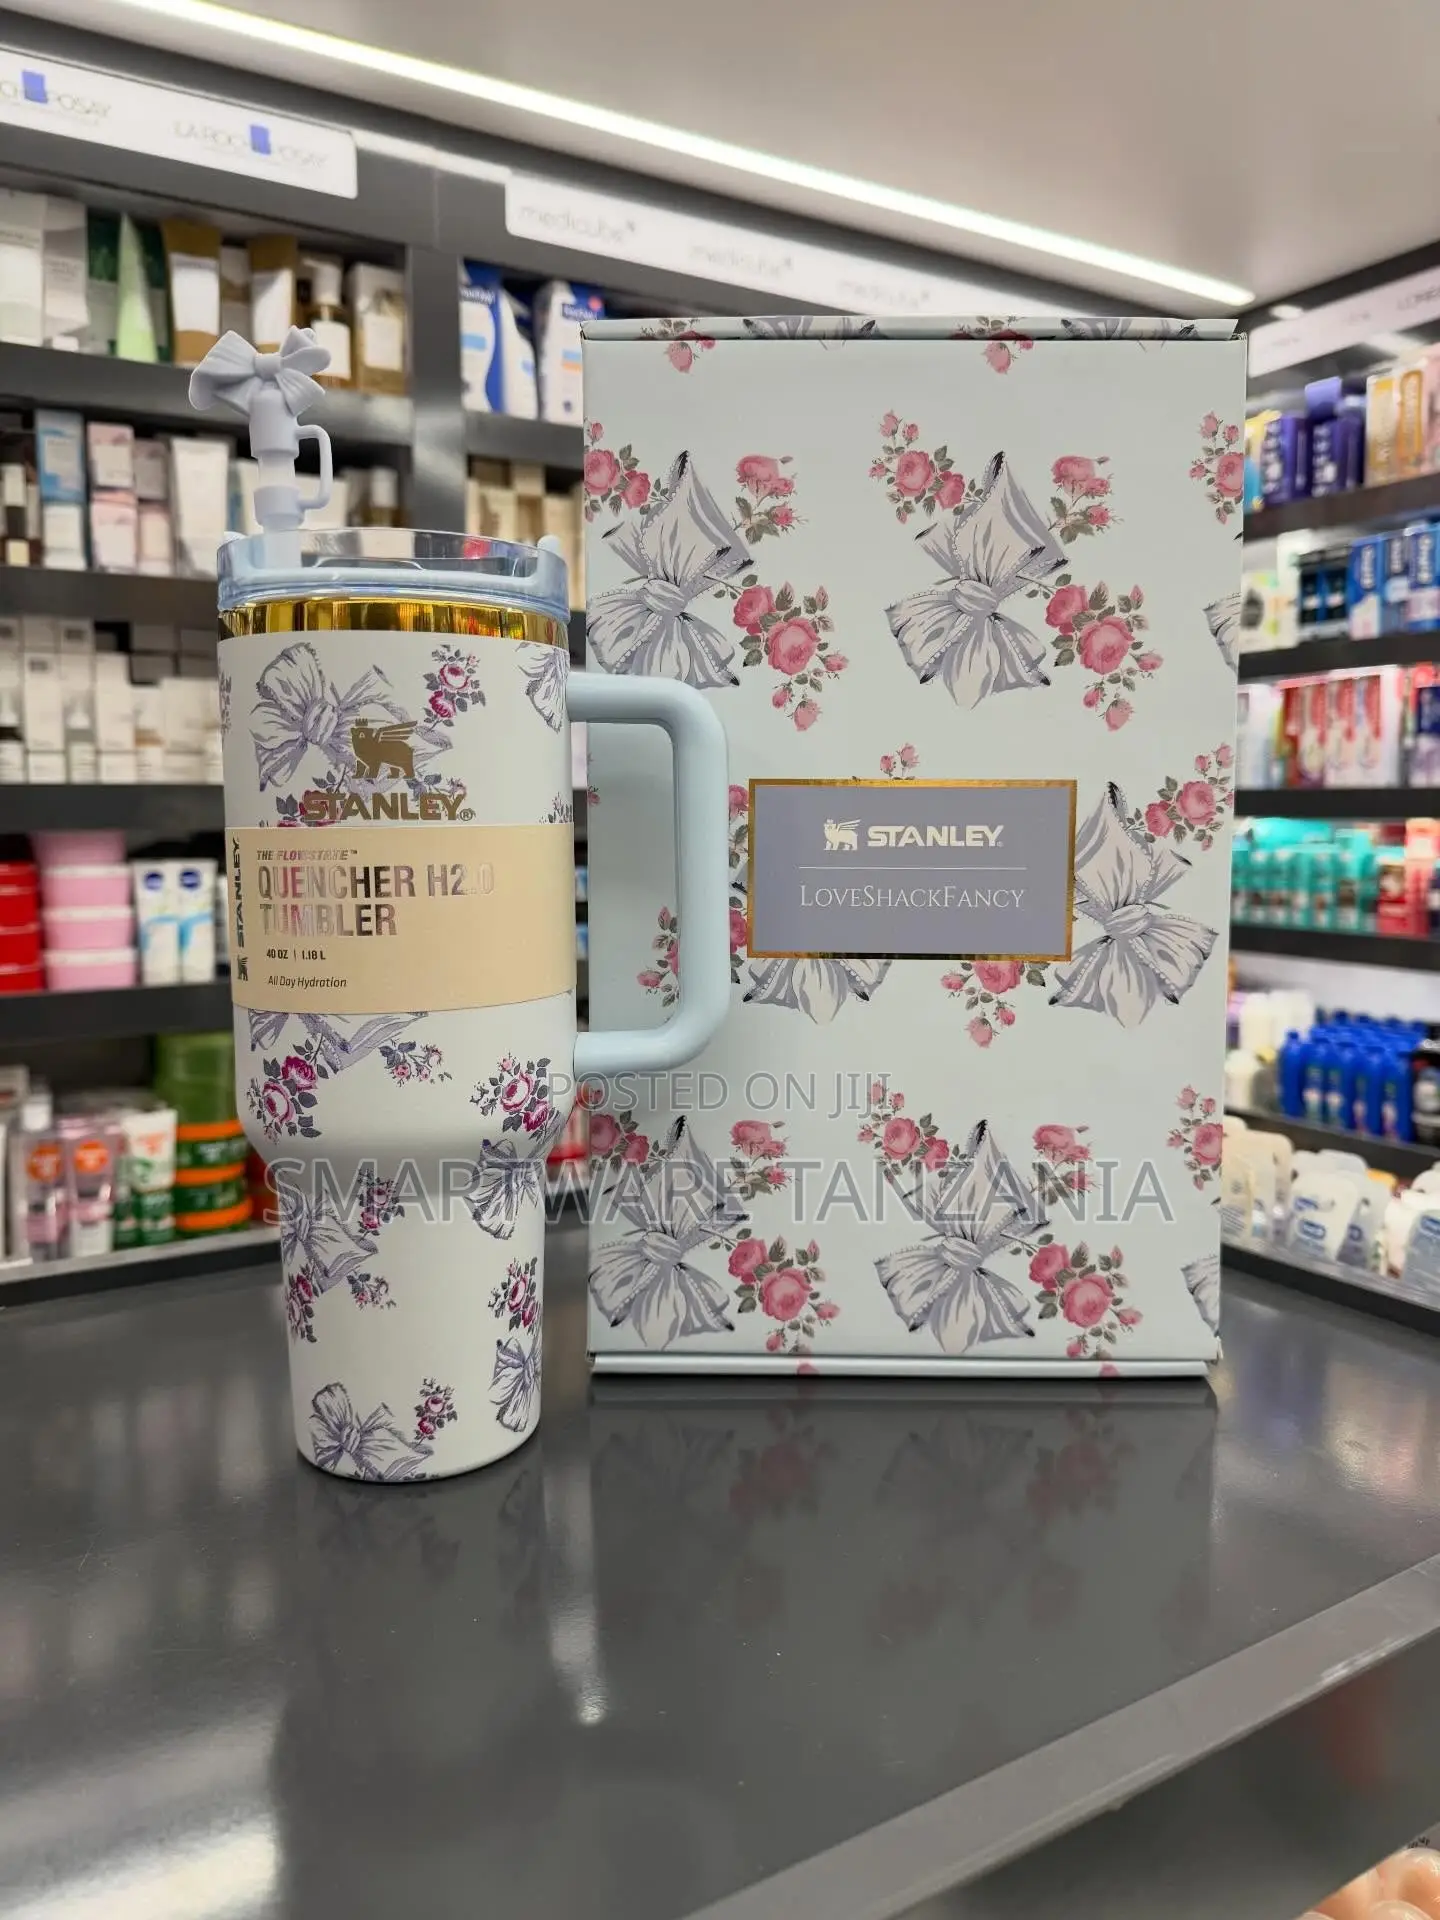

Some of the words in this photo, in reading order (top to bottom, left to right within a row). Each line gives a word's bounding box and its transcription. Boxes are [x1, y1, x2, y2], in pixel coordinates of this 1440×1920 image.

[256, 849, 274, 861] THE
[258, 864, 416, 900] QUENCHER
[259, 903, 397, 937] TUMBLER
[266, 948, 276, 959] 40
[277, 949, 289, 960] OZ
[320, 950, 327, 960] L
[268, 975, 279, 986] All
[280, 975, 296, 988] Day
[297, 976, 347, 989] Hydration
